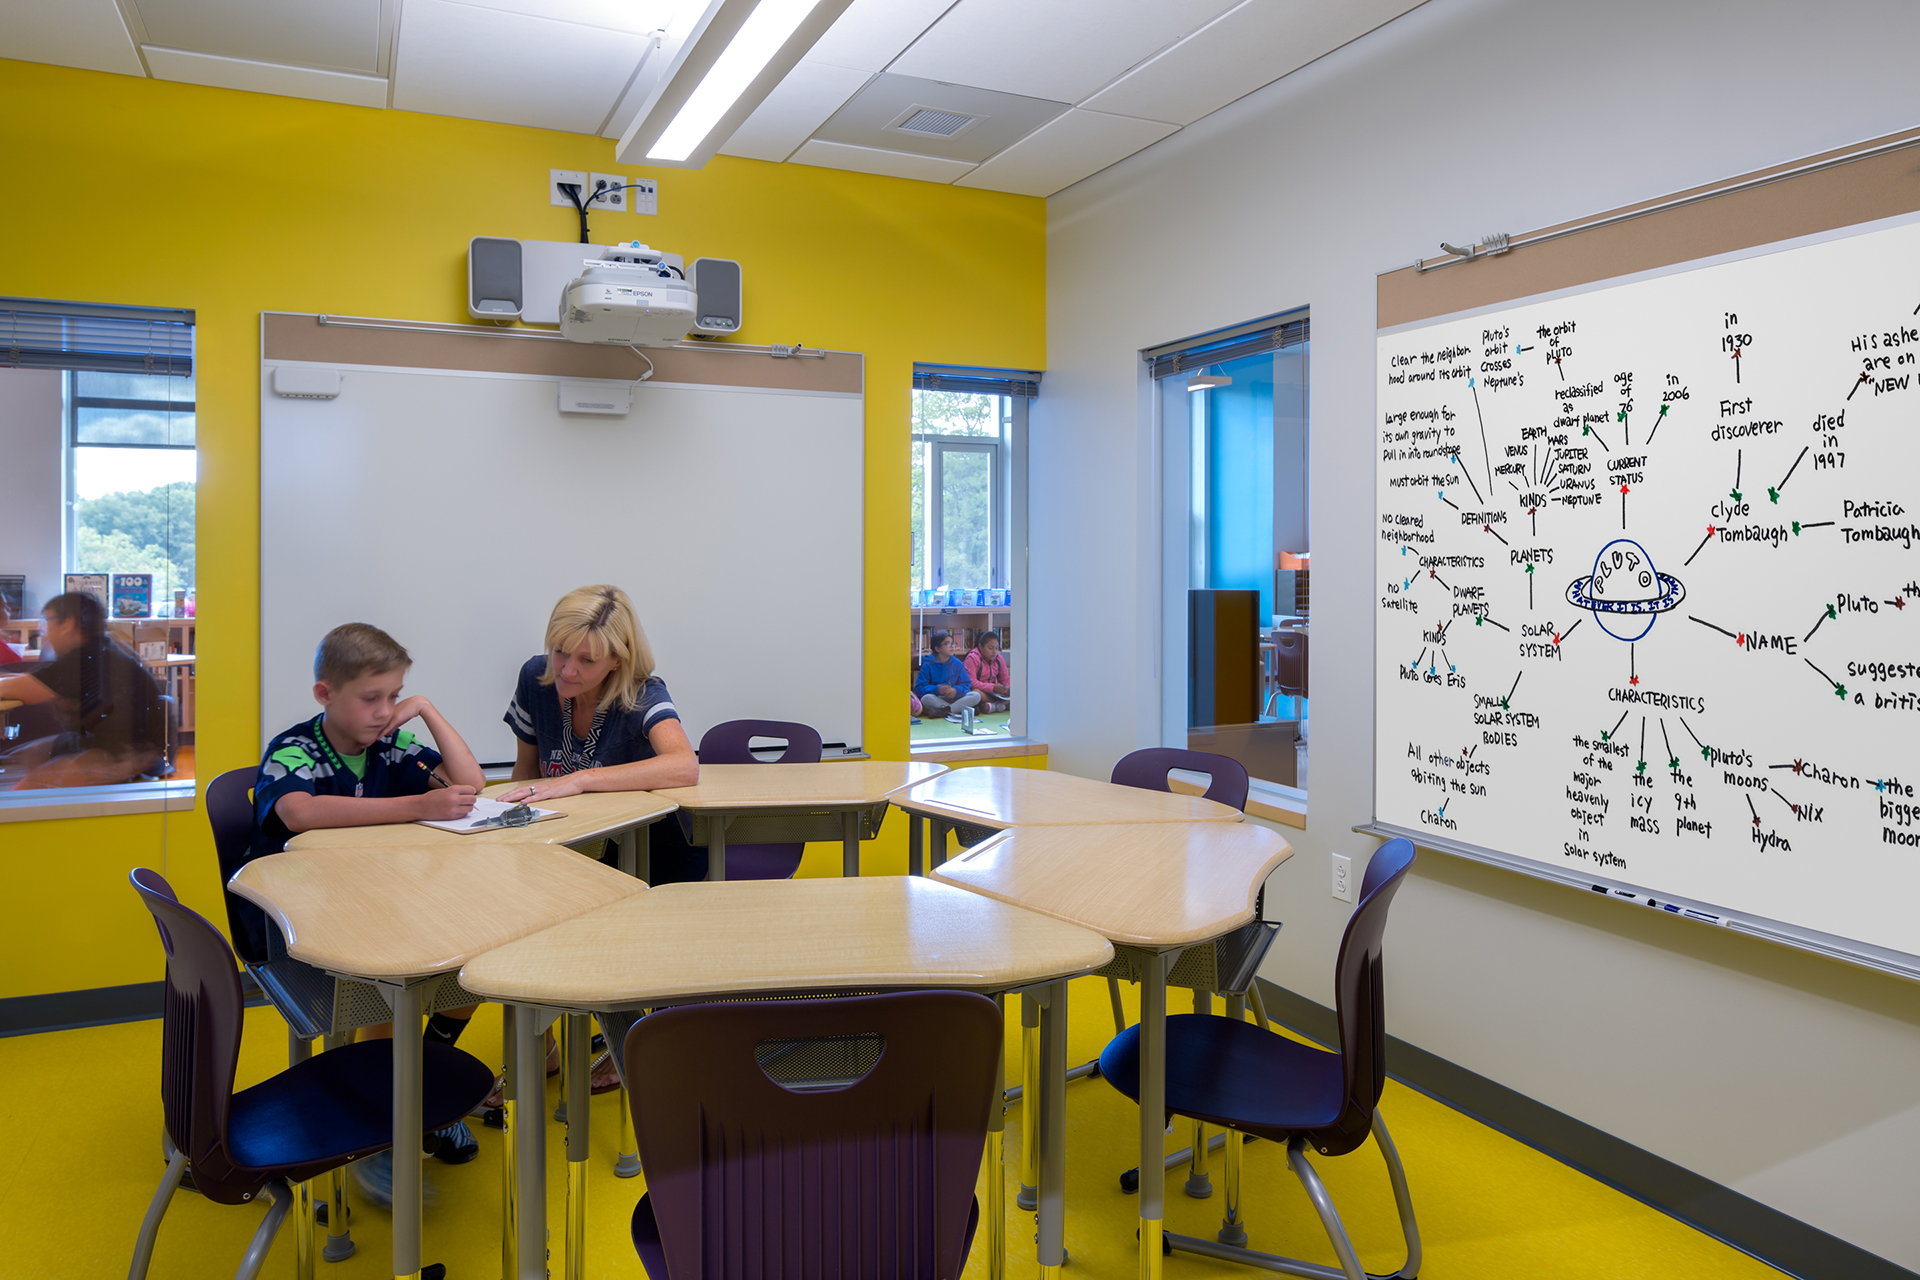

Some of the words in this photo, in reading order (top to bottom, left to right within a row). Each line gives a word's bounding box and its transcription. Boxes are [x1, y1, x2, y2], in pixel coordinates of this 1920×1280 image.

[1725, 312, 1738, 329] in
[1536, 323, 1551, 339] the
[1553, 321, 1576, 335] orbit
[1485, 342, 1508, 357] orbit
[1549, 336, 1560, 348] of
[1722, 333, 1753, 352] 1930
[1851, 334, 1878, 352] His
[1421, 351, 1435, 365] the
[1862, 356, 1891, 371] are
[1897, 352, 1915, 365] on
[1388, 370, 1405, 385] hood
[1408, 368, 1436, 383] around
[1439, 369, 1450, 380] its
[1451, 365, 1472, 379] orbit
[1483, 371, 1524, 393] Neptune's
[1613, 372, 1633, 389] age
[1666, 373, 1680, 386] in
[1554, 381, 1604, 400] reclassified
[1620, 385, 1632, 397] of
[1662, 386, 1690, 402] 2006
[1410, 408, 1439, 423] enough
[1441, 404, 1456, 421] for
[1562, 402, 1574, 414] as
[1618, 398, 1634, 413] 76
[1720, 396, 1753, 418] First
[1553, 412, 1581, 429] dwarf
[1582, 411, 1610, 431] planet
[1812, 408, 1845, 432] died
[1383, 430, 1393, 444] its
[1395, 430, 1409, 442] own
[1411, 427, 1441, 446] gravity
[1443, 425, 1455, 437] to
[1521, 425, 1547, 441] EARTH
[1711, 418, 1783, 441] discoverer
[1547, 434, 1569, 446] MARS
[1823, 433, 1839, 448] in
[1398, 449, 1407, 461] in
[1408, 446, 1421, 460] into
[1504, 444, 1529, 458] VENUS
[1554, 447, 1589, 460] JUPITER
[1494, 463, 1526, 477] MERCURY
[1558, 462, 1591, 475] SATURN
[1607, 456, 1648, 472] CURRENT
[1813, 452, 1846, 471] 1997
[1409, 473, 1429, 487] orbit
[1431, 474, 1445, 487] the
[1560, 478, 1596, 490] URANUS
[1609, 472, 1644, 485] STATUS
[1519, 492, 1547, 508] KINDS
[1843, 500, 1905, 519] Patricia
[1461, 511, 1508, 526] DEFINITIONS
[1381, 529, 1435, 544] neighborhood
[1715, 525, 1789, 548] Tombaugh
[1841, 525, 1920, 550] Tombaugh
[1419, 555, 1485, 569] CHARACTERISTICS
[1510, 547, 1553, 566] PLANETS
[120, 576, 143, 587] 100
[1594, 551, 1652, 595] PLUTO
[1453, 585, 1485, 600] DWARF
[1452, 602, 1490, 618] PLANETS
[1616, 601, 1629, 612] IT
[1647, 601, 1660, 611] IT
[1836, 593, 1879, 614] Pluto
[1422, 629, 1446, 645] KINDS
[1521, 621, 1555, 637] SOLAR
[1745, 630, 1798, 655] NAME
[1519, 644, 1562, 661] SYSTEM
[1399, 664, 1419, 682] Pluto
[1447, 673, 1466, 689] Eris
[1473, 693, 1503, 709] SMALL
[1608, 687, 1705, 714] CHARACTERISTICS
[1854, 692, 1865, 706] a
[1473, 712, 1504, 726] SOLAR
[1505, 712, 1540, 729] SYSTEM
[1482, 731, 1518, 747] BODIES
[1572, 735, 1590, 750] the
[1592, 740, 1630, 757] smallest
[1407, 741, 1421, 761] All
[1428, 749, 1455, 767] other
[1456, 755, 1490, 777] objects
[1582, 753, 1596, 767] of
[1597, 756, 1613, 771] the
[1573, 771, 1602, 788] major
[1632, 773, 1654, 788] the
[1670, 769, 1693, 788] the
[1723, 770, 1769, 792] moons
[1801, 762, 1860, 790] Charon
[1450, 778, 1466, 794] the
[1469, 783, 1487, 797] sun
[1883, 776, 1914, 798] the
[1566, 785, 1609, 813] heavenly
[1631, 793, 1653, 814] icy
[1674, 792, 1697, 810] 9th
[1420, 809, 1457, 831] Charon
[1570, 807, 1605, 826] object
[1630, 815, 1660, 834] mass
[1578, 828, 1590, 842] in
[1676, 817, 1713, 839] planet
[1752, 826, 1792, 853] Hydra
[1593, 850, 1627, 870] system
